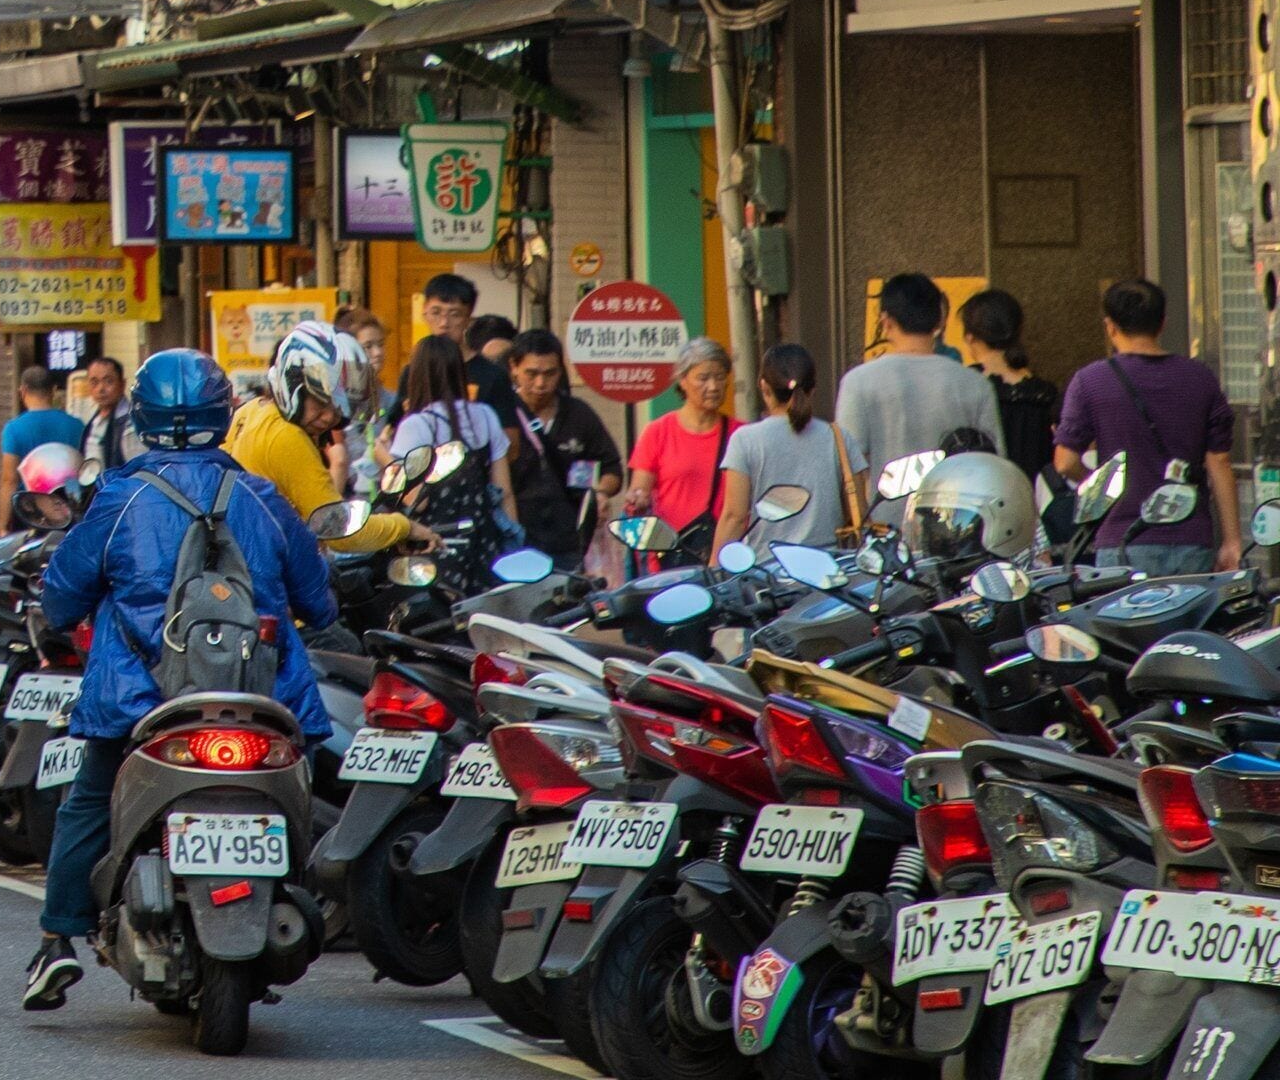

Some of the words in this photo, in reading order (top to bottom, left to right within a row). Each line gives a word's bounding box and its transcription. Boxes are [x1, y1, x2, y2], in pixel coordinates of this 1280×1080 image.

[436, 155, 481, 213] 許
[574, 326, 681, 348] 奶油小酥餅
[345, 745, 427, 775] 532-MHE
[205, 818, 249, 830] 台北市
[174, 834, 283, 865] A2V-959
[748, 828, 851, 865] 590-HUK
